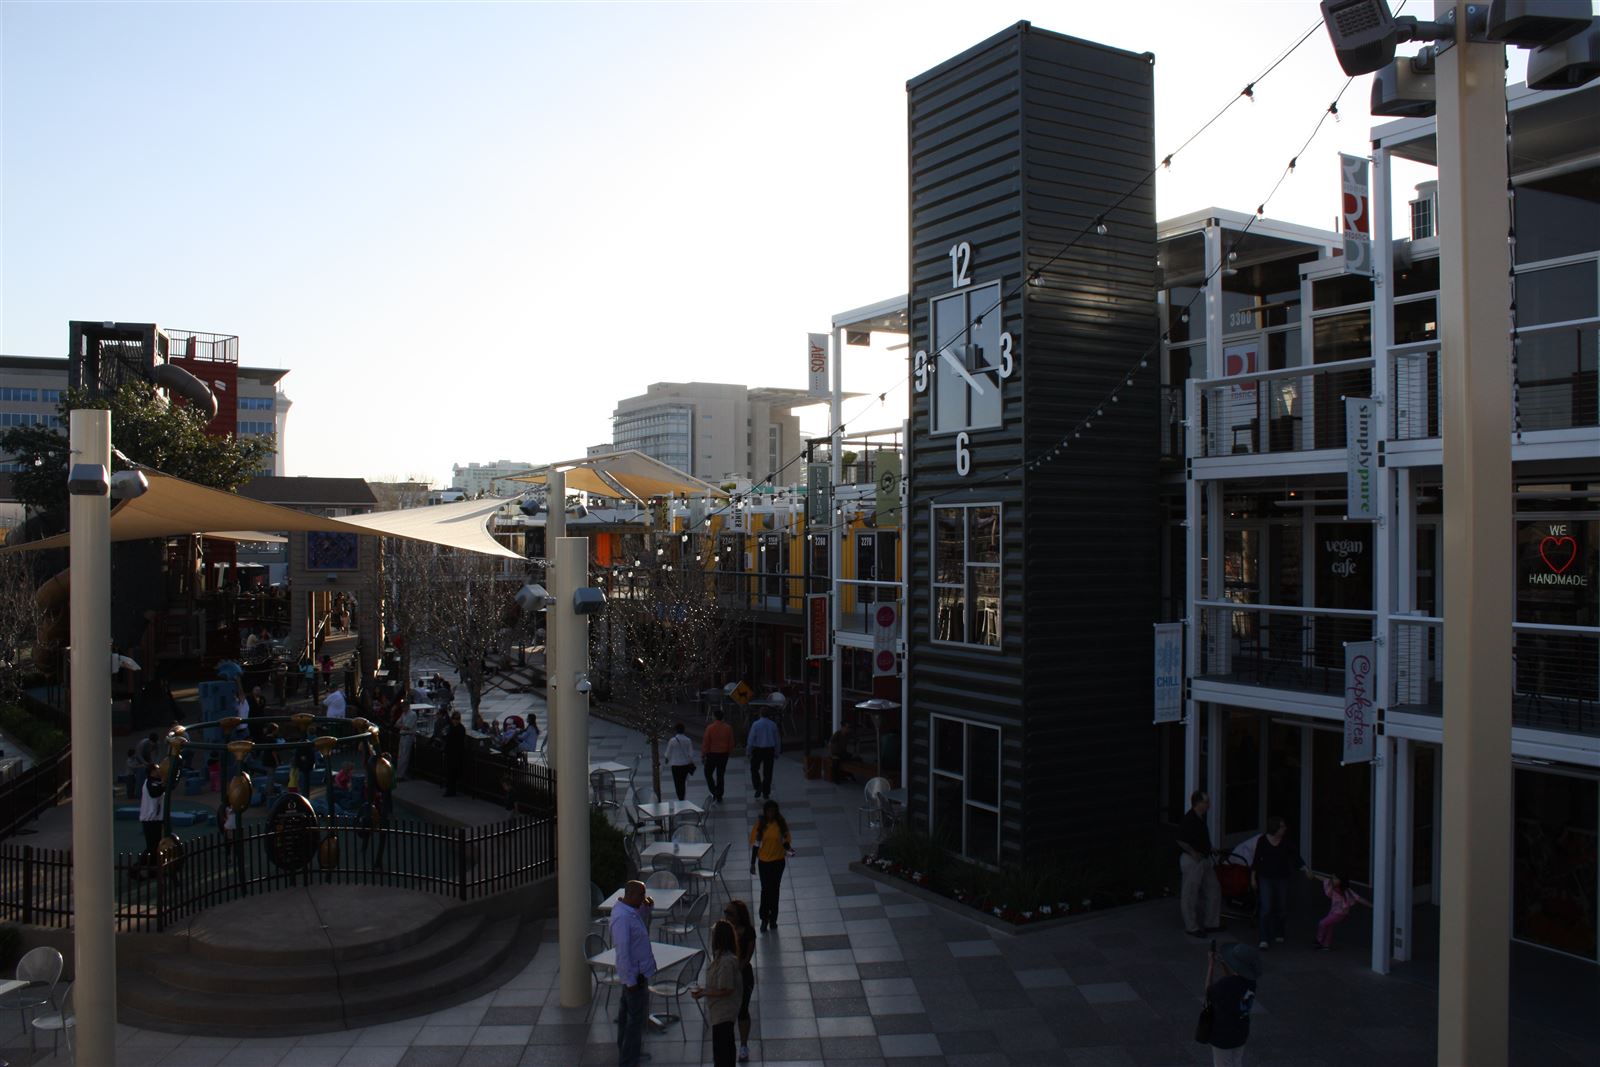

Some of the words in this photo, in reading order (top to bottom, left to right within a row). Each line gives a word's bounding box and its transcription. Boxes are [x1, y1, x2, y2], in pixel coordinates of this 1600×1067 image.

[949, 241, 971, 288] 12
[914, 350, 928, 392] 9
[999, 332, 1013, 378] 3
[956, 431, 970, 476] 6
[1356, 404, 1372, 512] simplypure
[1325, 539, 1363, 557] vegan
[1549, 524, 1567, 536] WE
[1331, 557, 1358, 578] cafe
[1528, 573, 1588, 586] HANDMADE
[1156, 676, 1180, 688] CHILL
[1345, 655, 1372, 745] Cupkates
